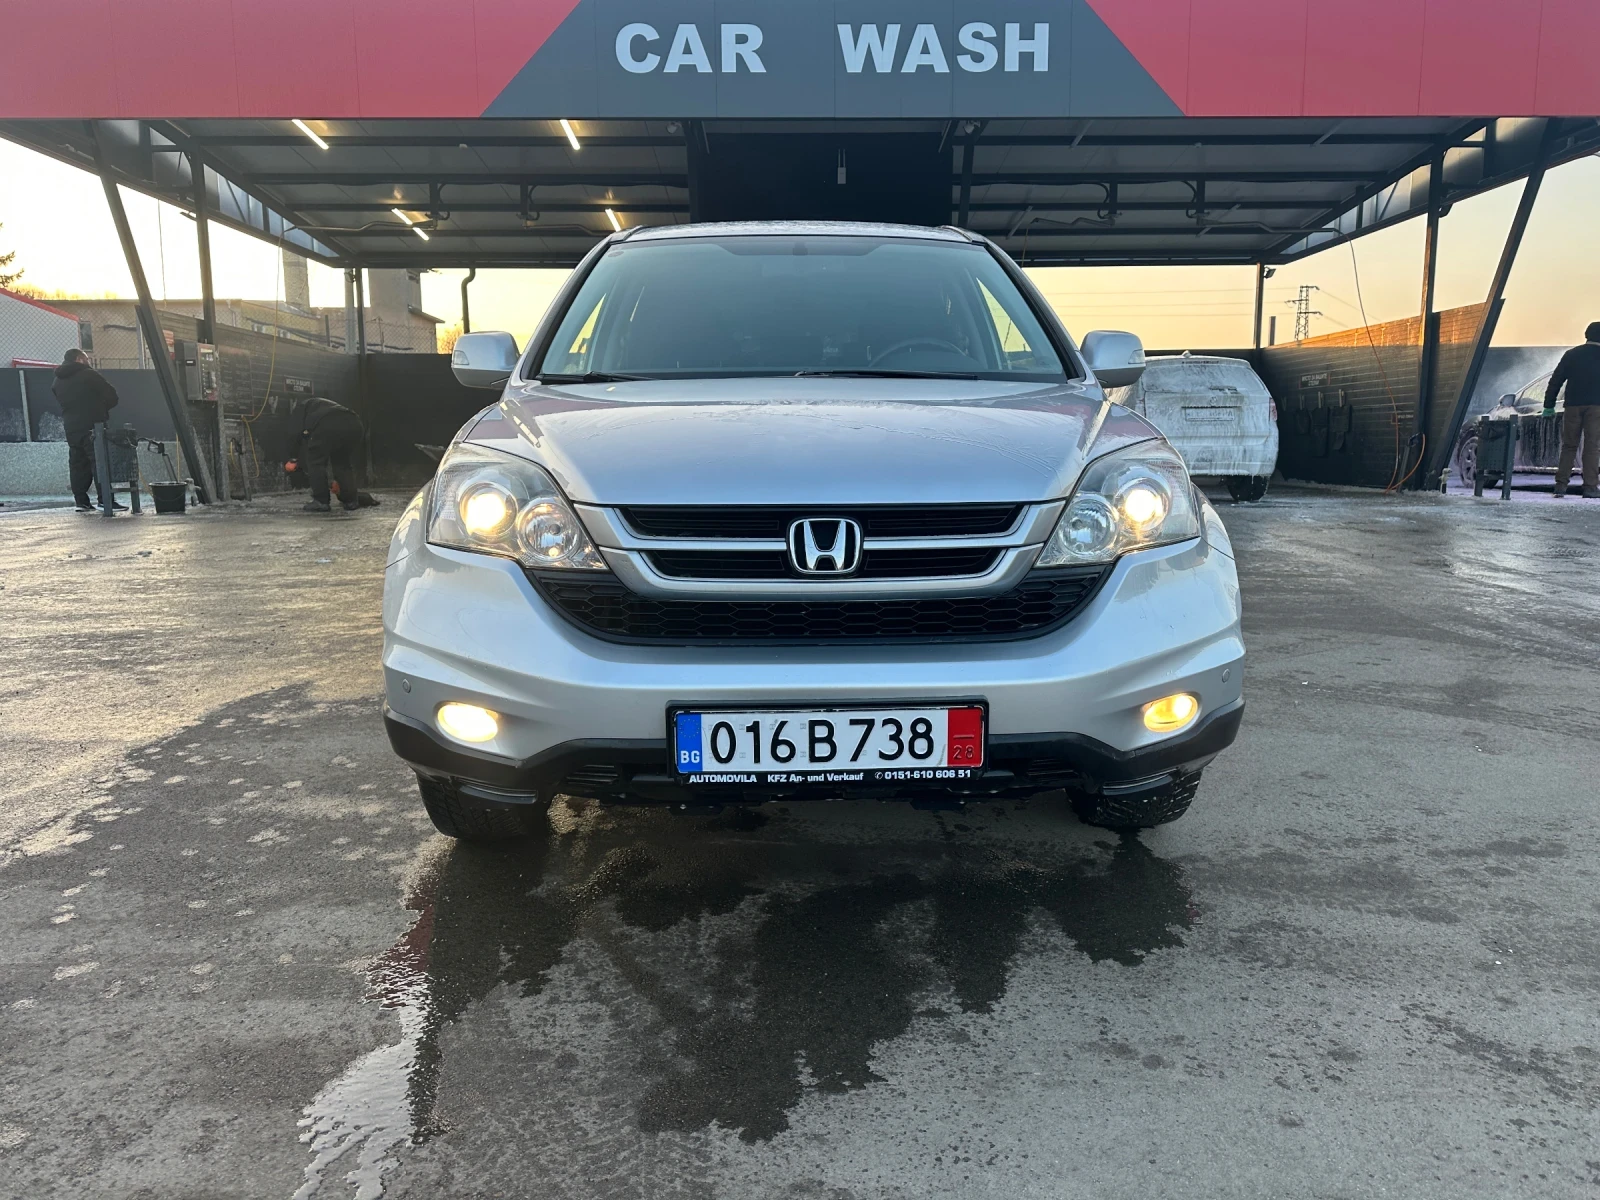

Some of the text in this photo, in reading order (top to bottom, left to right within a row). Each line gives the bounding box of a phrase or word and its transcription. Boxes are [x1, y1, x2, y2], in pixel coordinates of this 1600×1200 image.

[615, 21, 1050, 74] CAR WASH
[680, 750, 700, 763] BG
[952, 745, 974, 759] 28
[689, 772, 864, 783] AUTOMOVILA KFZ An- und Verkauf
[884, 770, 934, 780] 0151-610
[957, 769, 971, 778] 51
